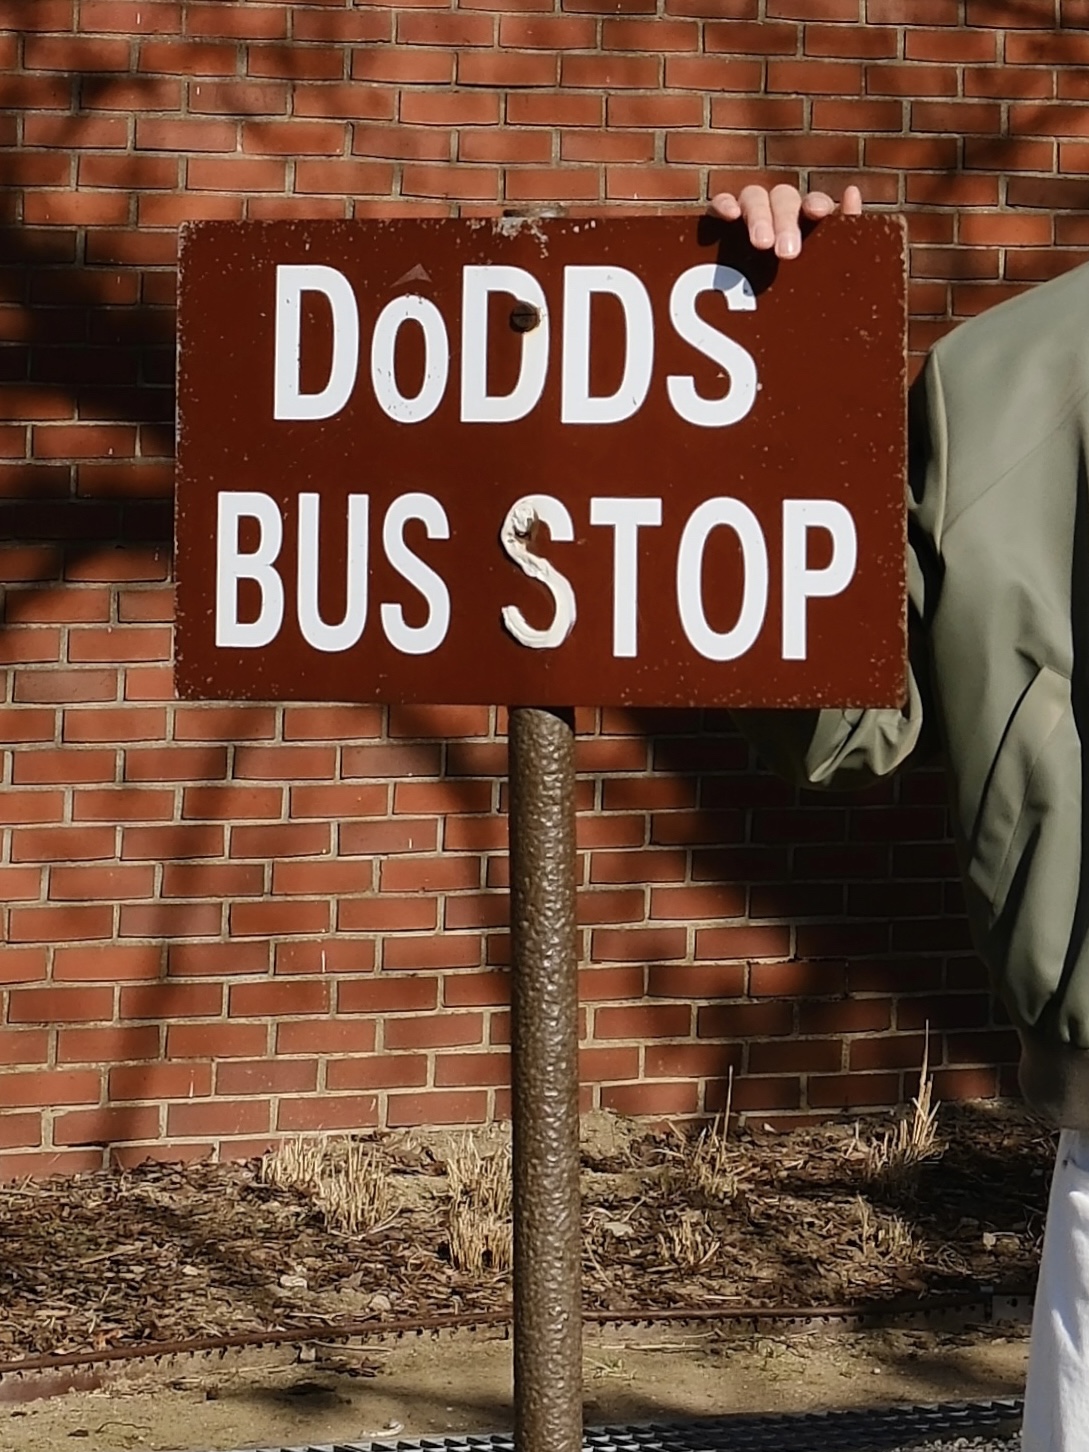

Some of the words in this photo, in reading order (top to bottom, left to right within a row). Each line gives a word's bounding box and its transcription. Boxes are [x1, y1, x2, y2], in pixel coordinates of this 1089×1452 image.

[273, 263, 759, 427] DoDDS
[215, 491, 450, 655] BUS
[500, 494, 858, 661] STOP
